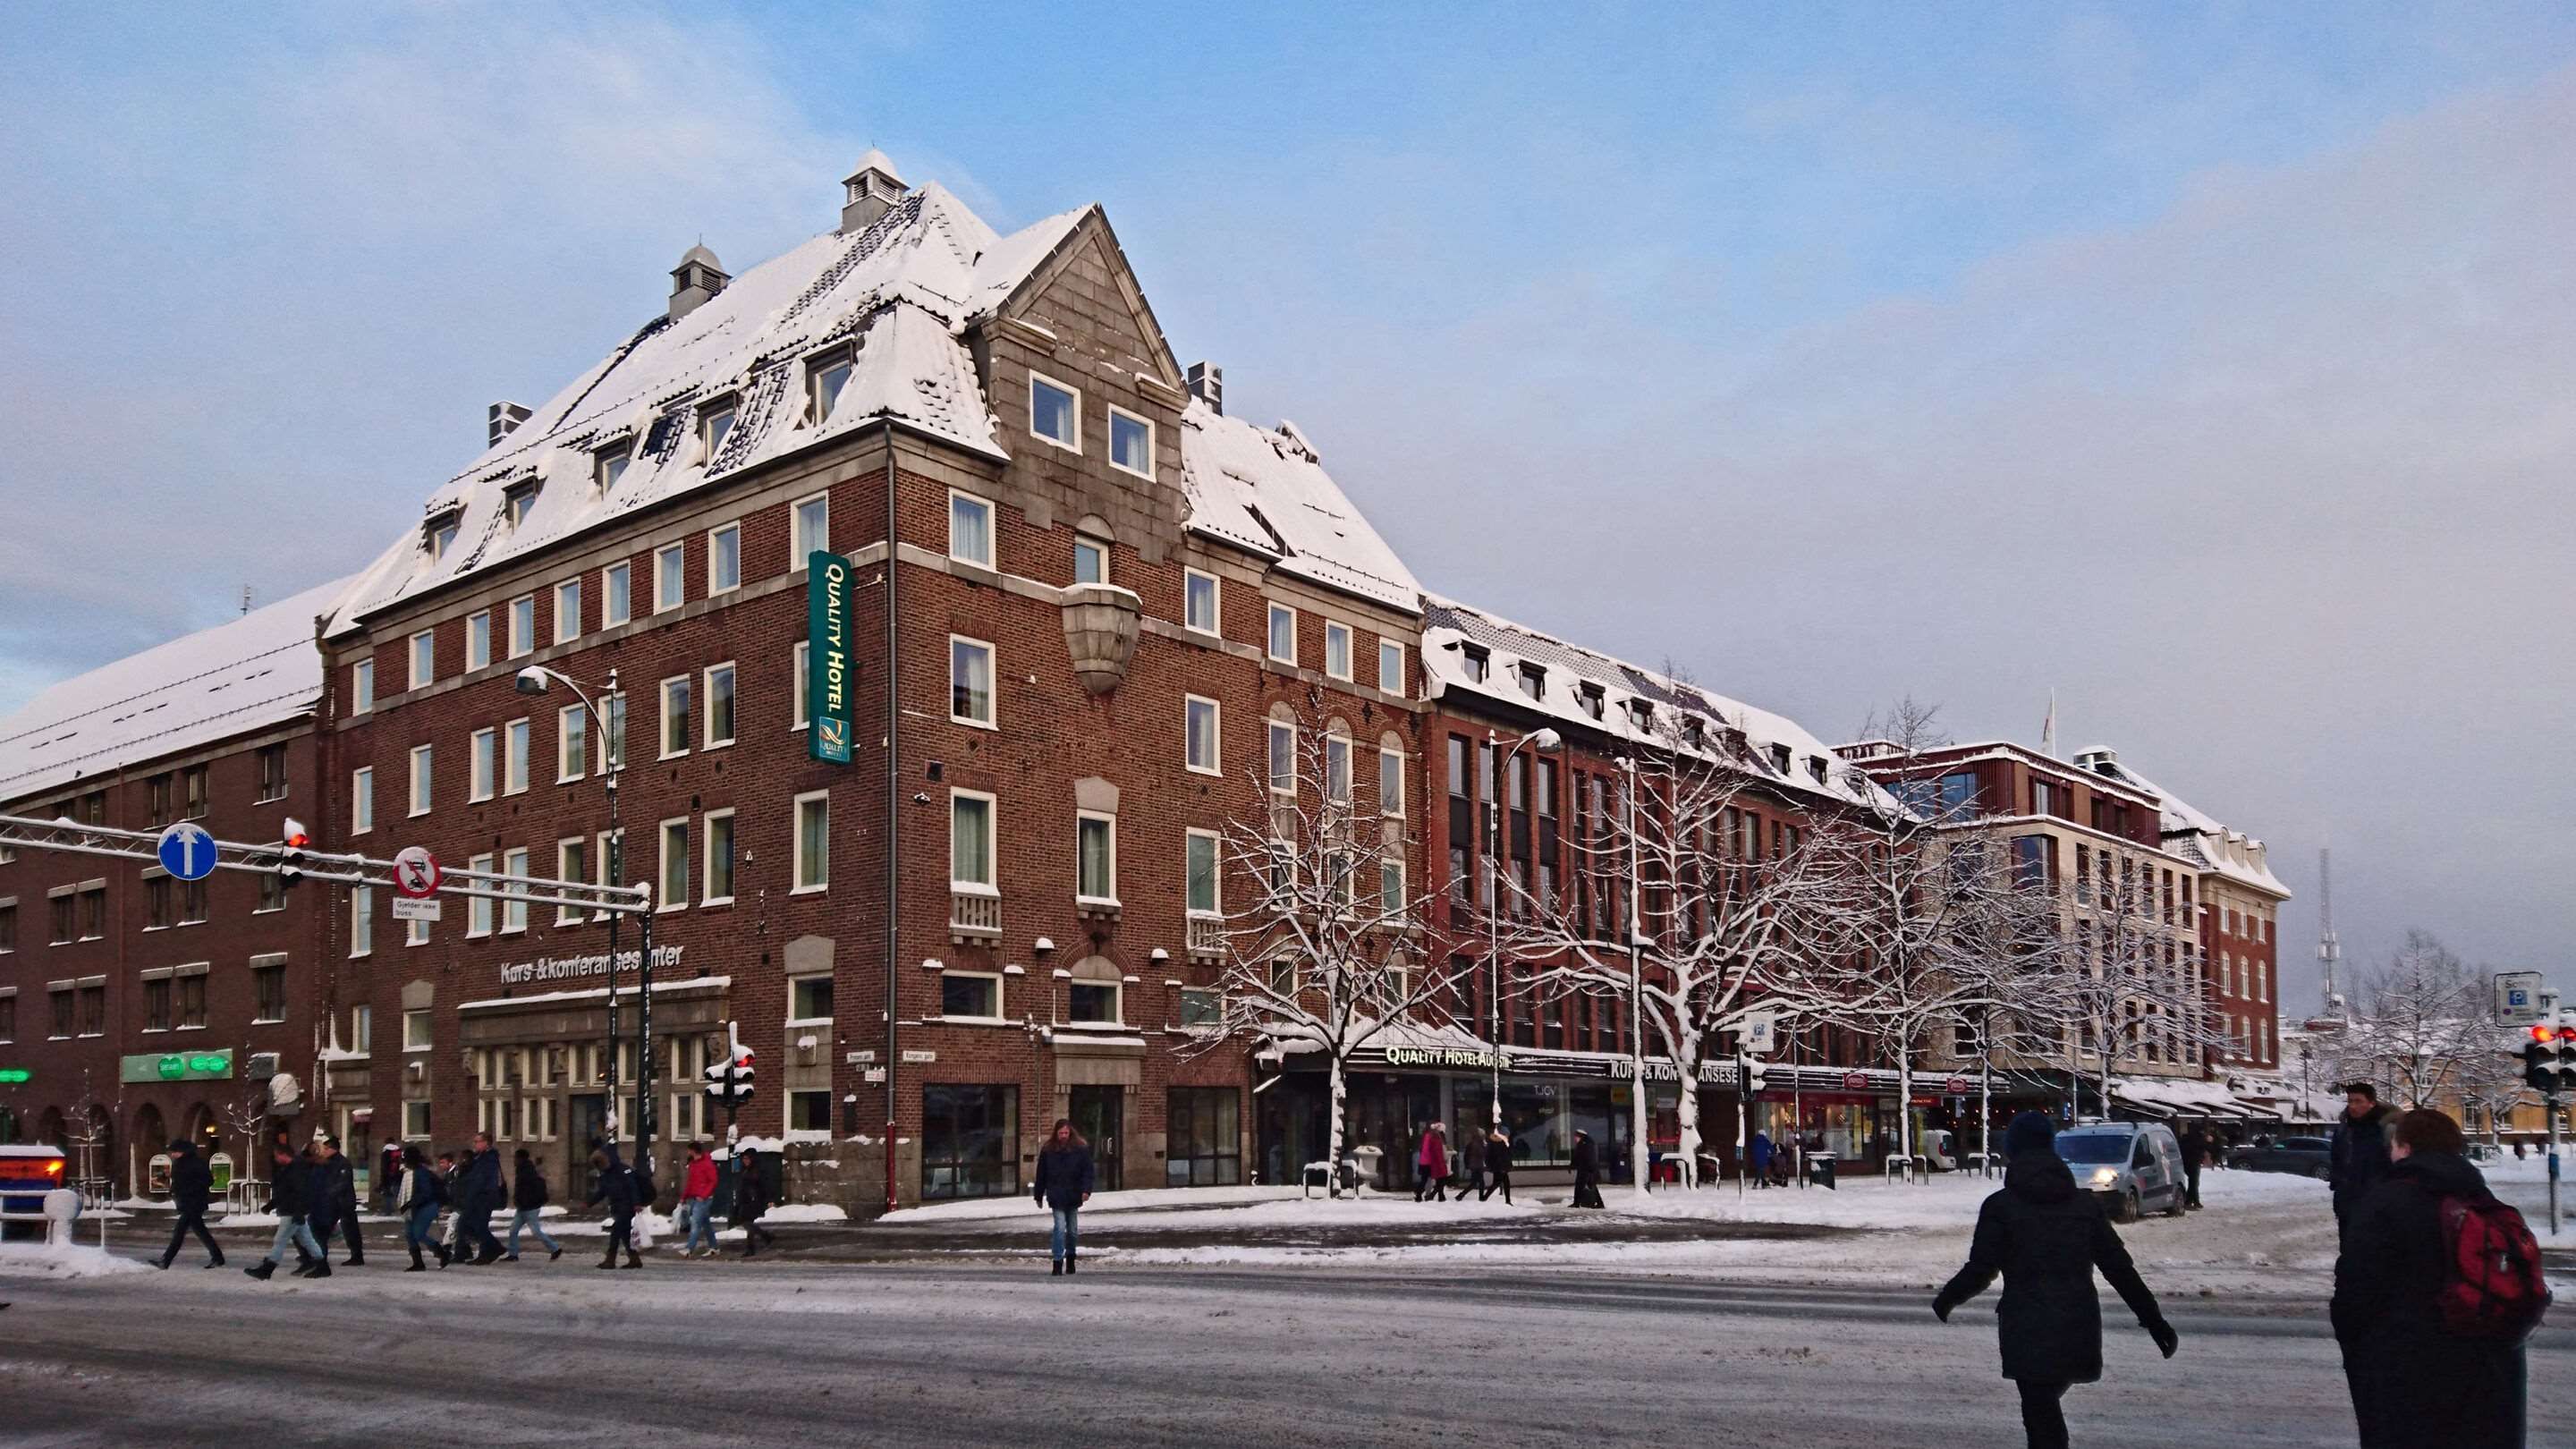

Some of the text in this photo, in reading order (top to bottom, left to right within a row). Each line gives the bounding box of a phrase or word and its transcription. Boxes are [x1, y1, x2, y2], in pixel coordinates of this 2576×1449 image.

[825, 564, 845, 713] QUALITY HOTEL
[548, 945, 685, 979] konferansesnter
[1386, 1046, 1510, 1068] QUALITY HOTEL AUSTIN
